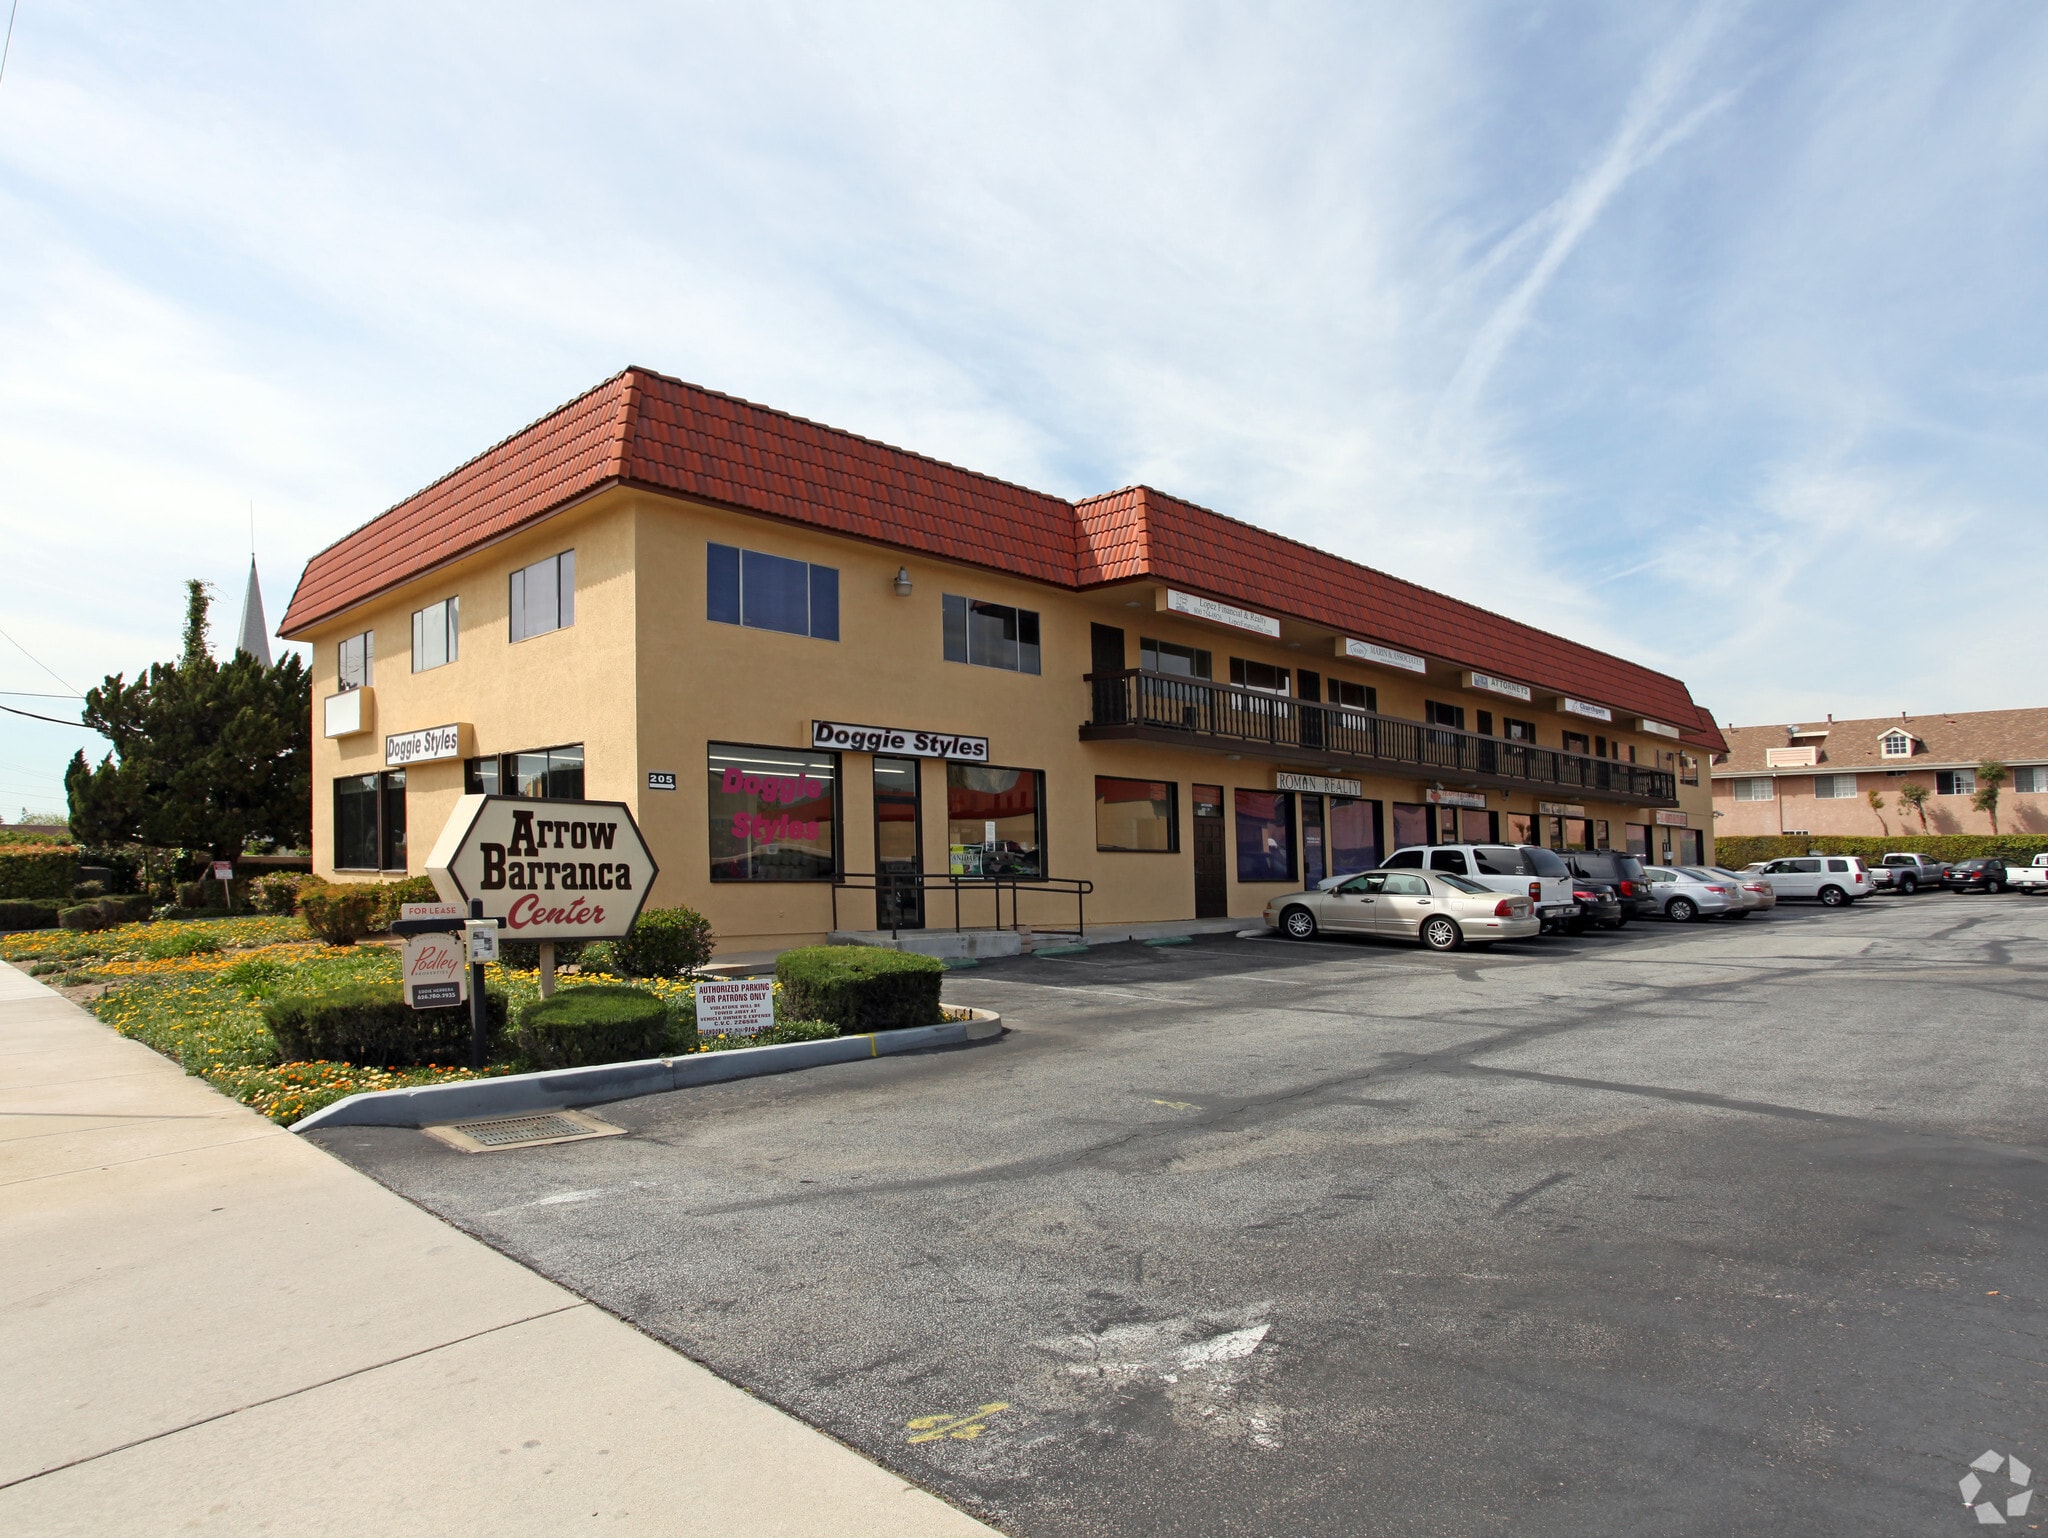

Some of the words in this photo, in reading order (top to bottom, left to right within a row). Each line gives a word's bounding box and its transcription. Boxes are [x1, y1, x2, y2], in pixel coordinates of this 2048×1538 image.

[1199, 598, 1217, 612] Lopez
[1218, 602, 1243, 619] Financial
[1249, 612, 1267, 627] Realty
[1370, 646, 1388, 658] MARIN
[1393, 651, 1423, 666] ASSOCIATES
[1491, 677, 1529, 695] ATTORNEYS
[387, 735, 421, 760] Doggie
[424, 728, 457, 756] Styles
[815, 722, 906, 754] Doggie
[913, 733, 985, 759] Styles
[649, 774, 673, 784] 205
[722, 767, 822, 805] Doggie
[1279, 773, 1316, 791] ROMAN
[1324, 777, 1360, 795] REALTY
[507, 809, 617, 857] Arrow
[731, 811, 821, 846] Styles
[480, 842, 632, 890] Barranca
[409, 907, 427, 915] FOR
[508, 893, 606, 930] Center
[410, 946, 459, 979] Podley
[699, 984, 739, 994] AUTHORIZED
[741, 982, 770, 992] PARKING
[702, 994, 716, 1003] FOR
[717, 993, 748, 1003] PATRONS
[749, 992, 766, 1001] ONLY
